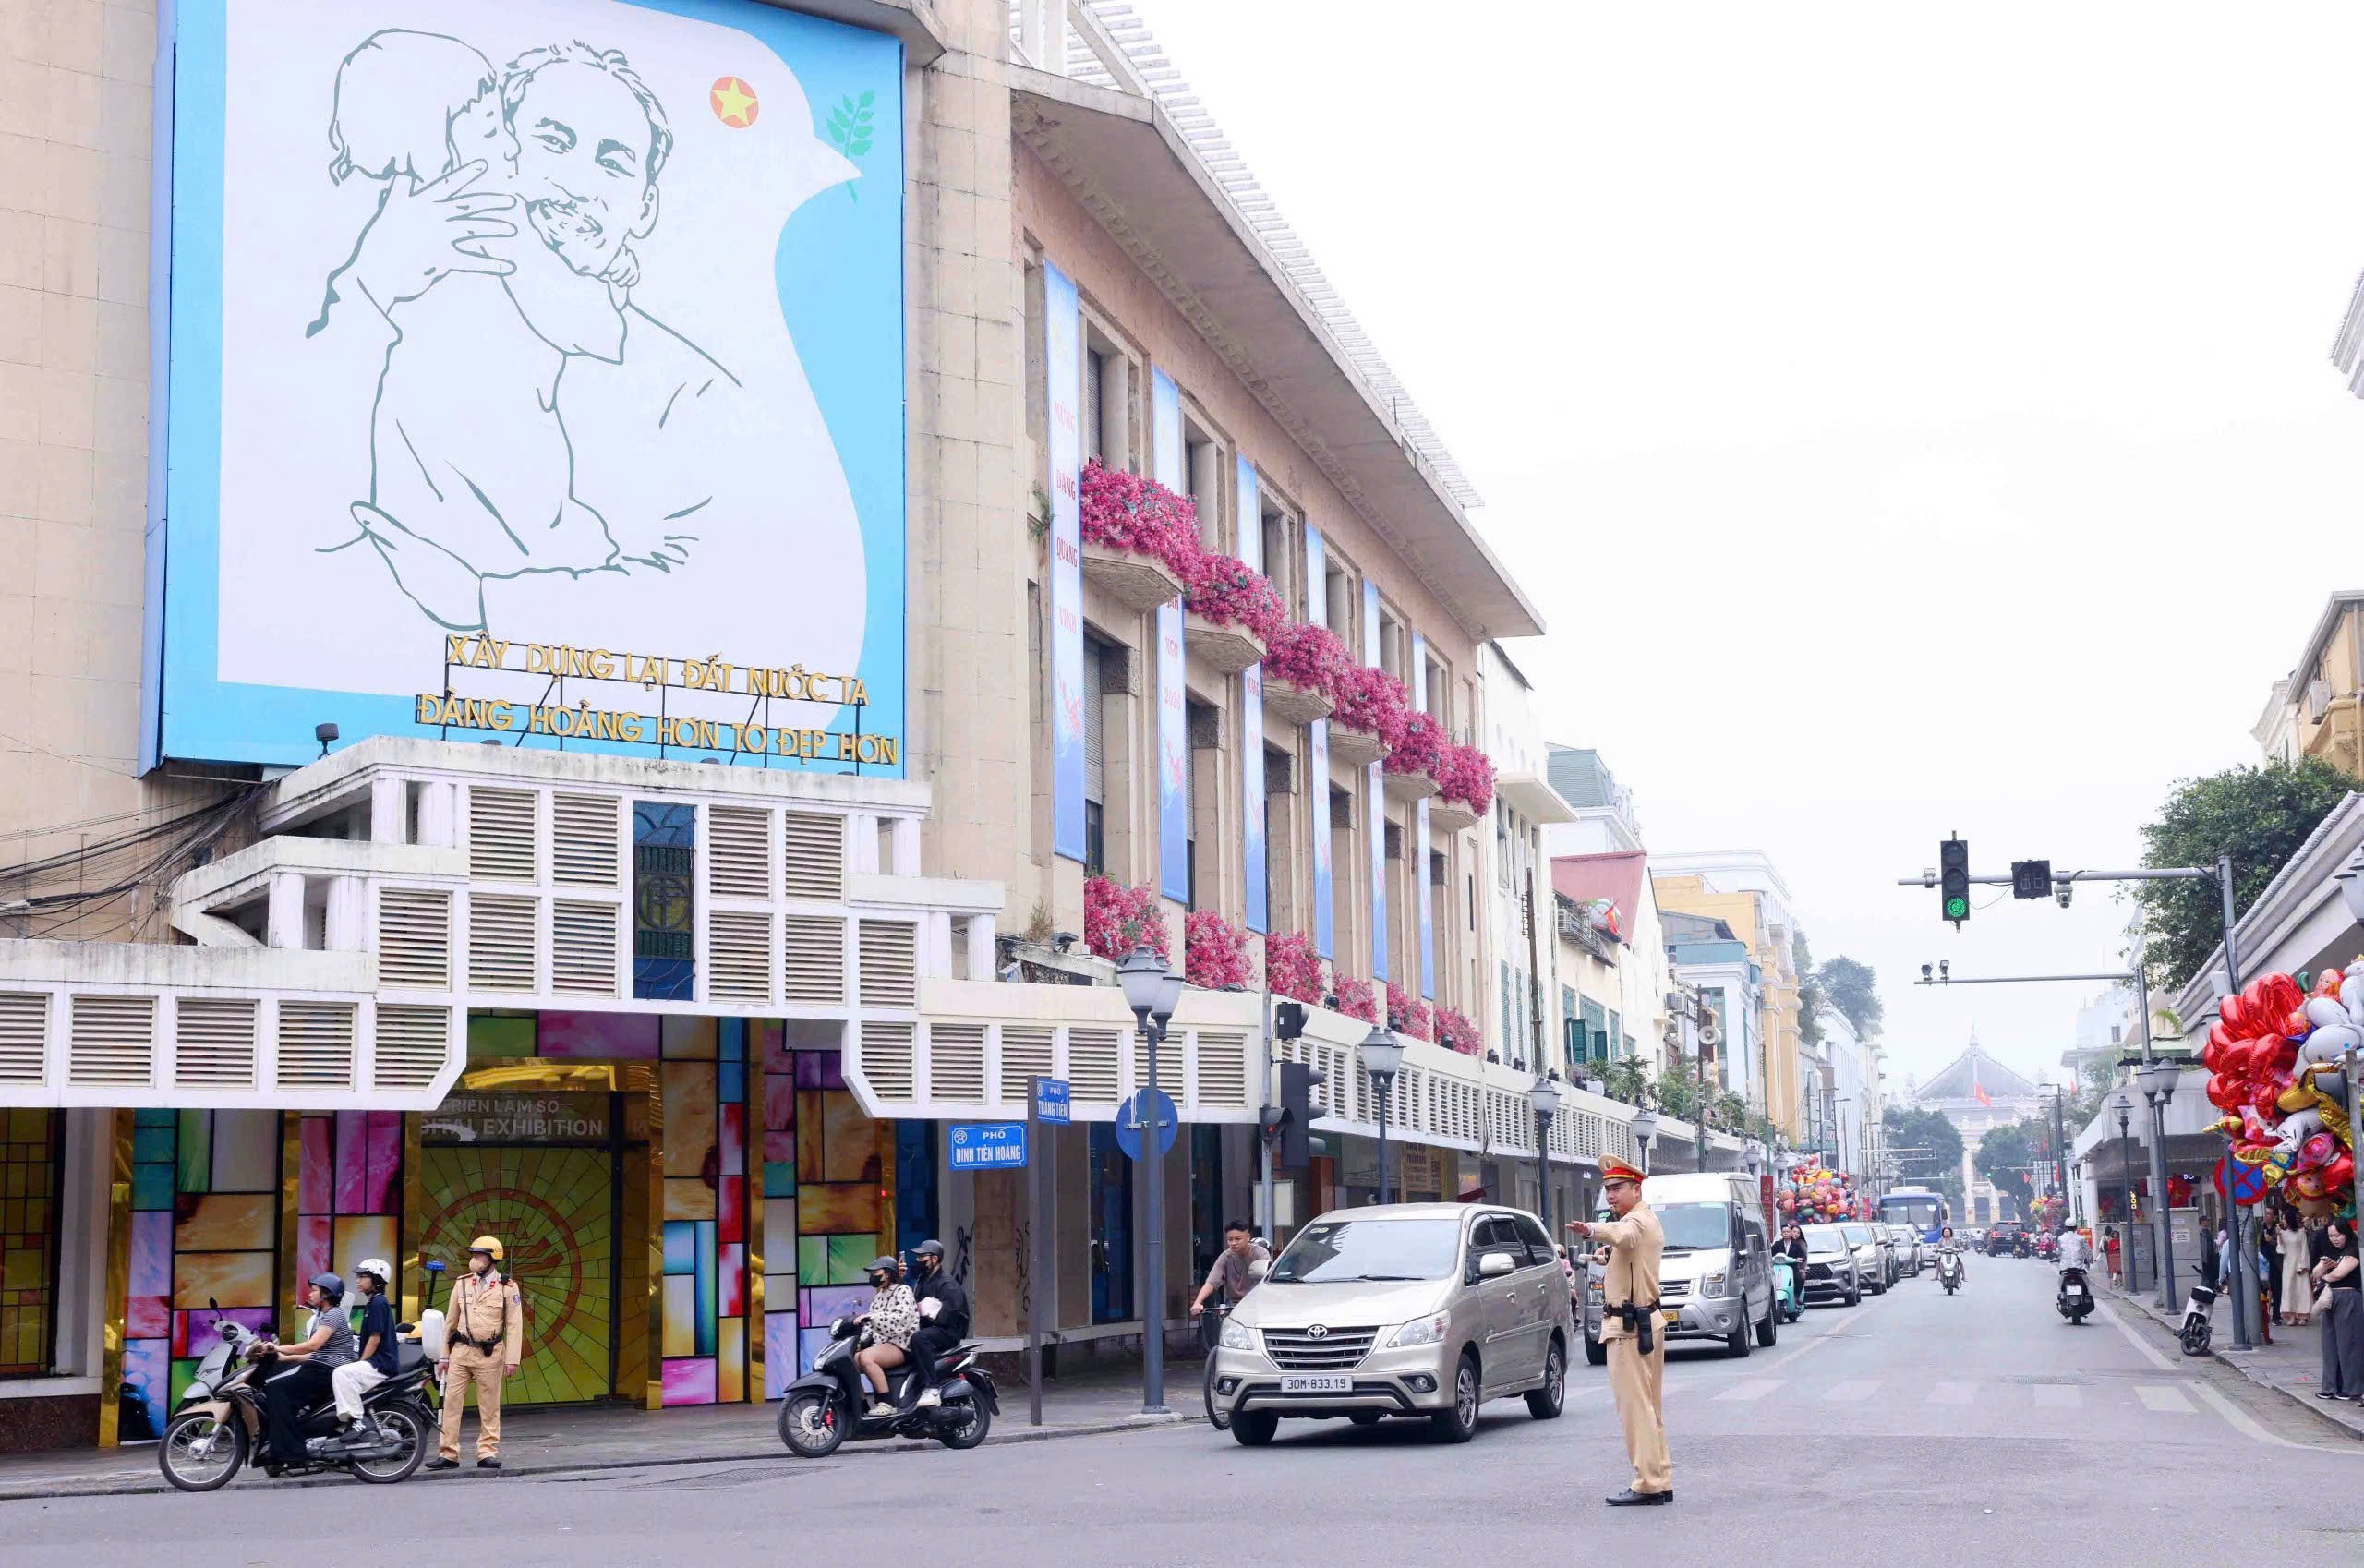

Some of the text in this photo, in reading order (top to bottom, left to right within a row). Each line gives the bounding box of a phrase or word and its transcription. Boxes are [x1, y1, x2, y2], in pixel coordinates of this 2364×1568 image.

[447, 630, 870, 706] XÂY DỰNG LẠI ĐẤT NƯỚC TA
[416, 686, 898, 766] ĐÀNG HOÀNG HƠN TO ĐẸP HƠN
[483, 1118, 603, 1137] EXHIBITION
[982, 1128, 1006, 1140] PHỐ
[995, 1142, 1021, 1161] HOÀNG
[1287, 1378, 1346, 1390] 30M-833.19
